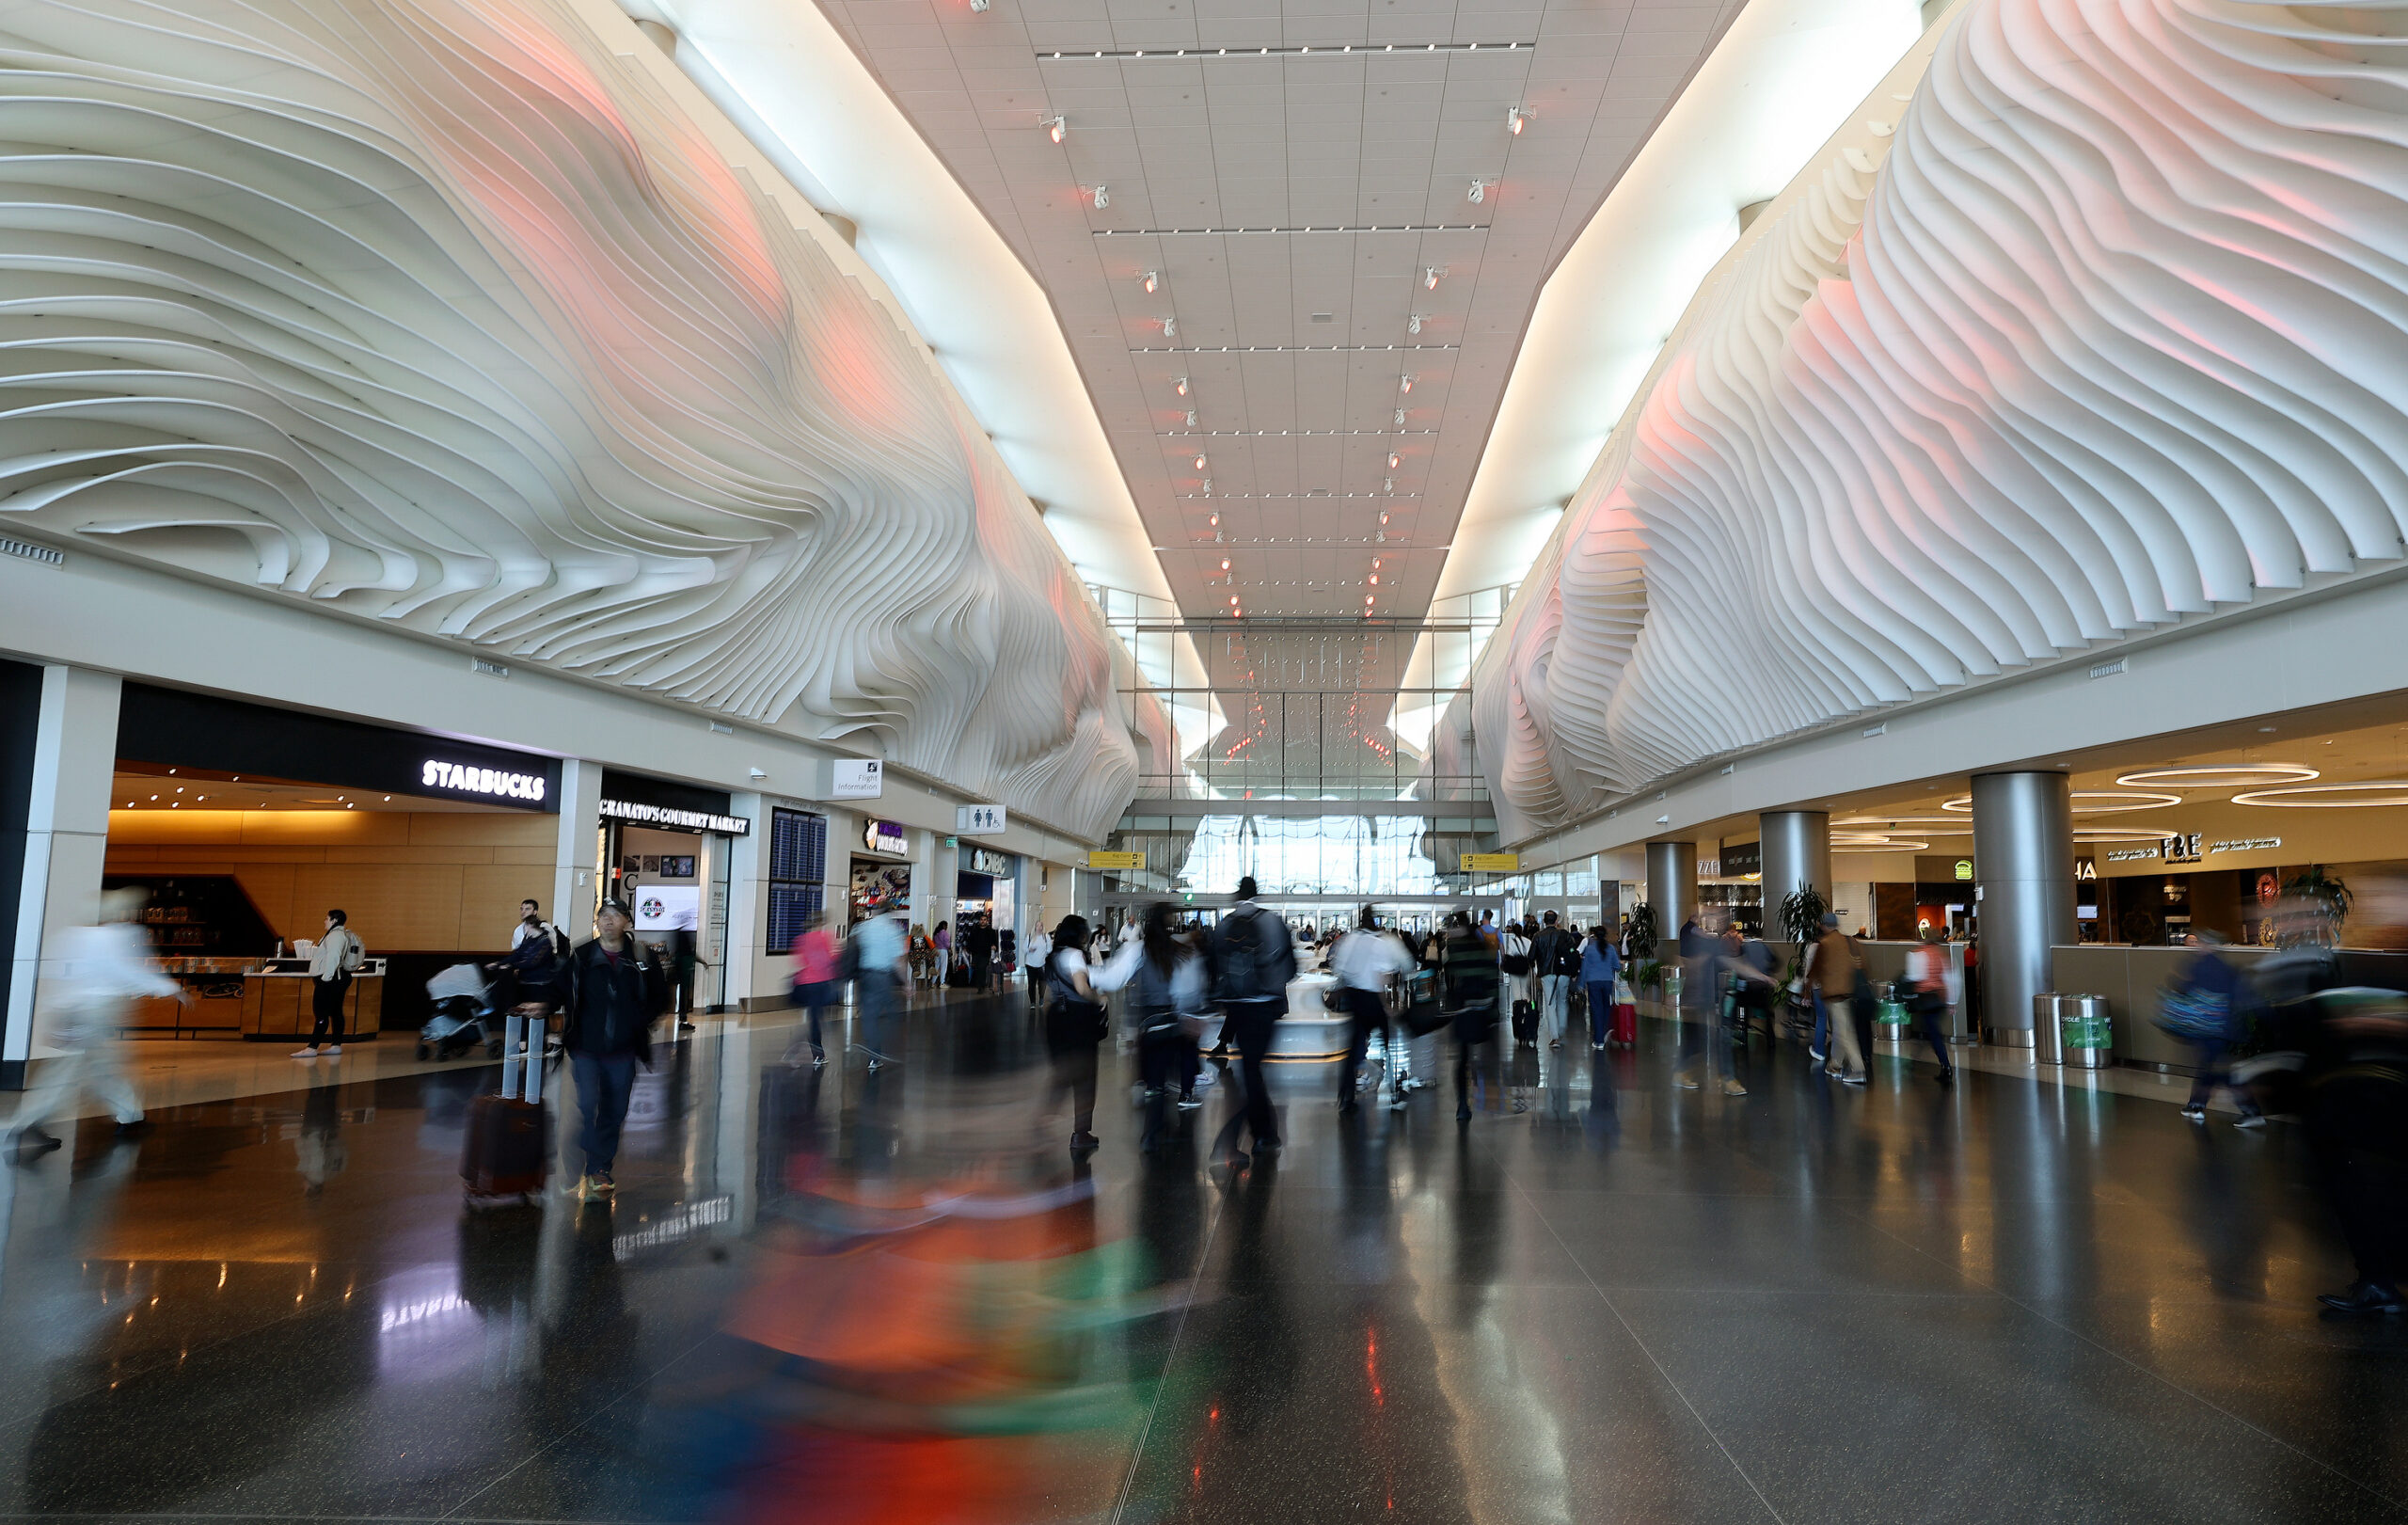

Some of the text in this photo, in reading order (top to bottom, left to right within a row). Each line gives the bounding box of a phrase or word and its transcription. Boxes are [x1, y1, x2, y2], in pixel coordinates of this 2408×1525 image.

[421, 759, 546, 801] STARBUCKS
[858, 774, 878, 783] Flight
[659, 807, 709, 829] GOURMET
[707, 814, 748, 834] MARKET
[983, 850, 1007, 875] CNBC
